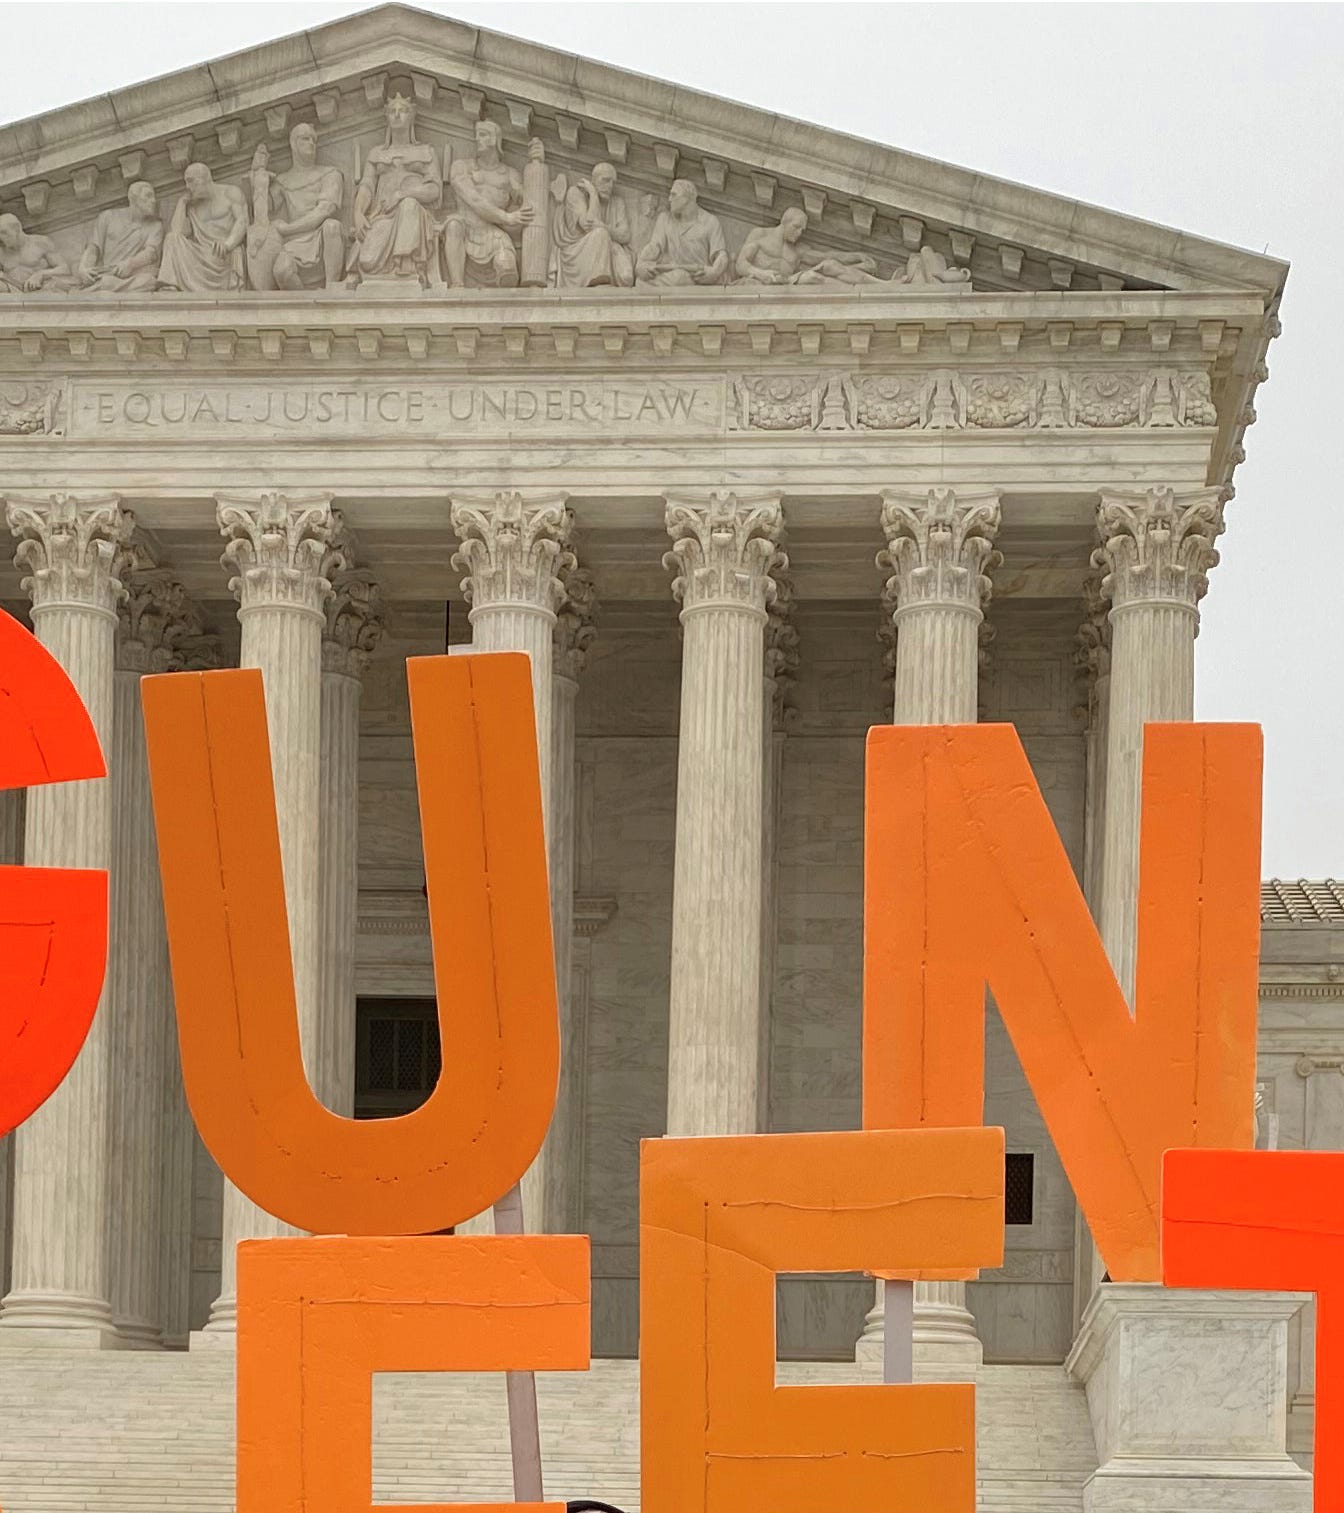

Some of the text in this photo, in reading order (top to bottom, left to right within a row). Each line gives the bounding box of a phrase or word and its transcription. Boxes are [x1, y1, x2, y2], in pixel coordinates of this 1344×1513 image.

[96, 388, 699, 426] EQUAL JUSTICE UNDER LAW
